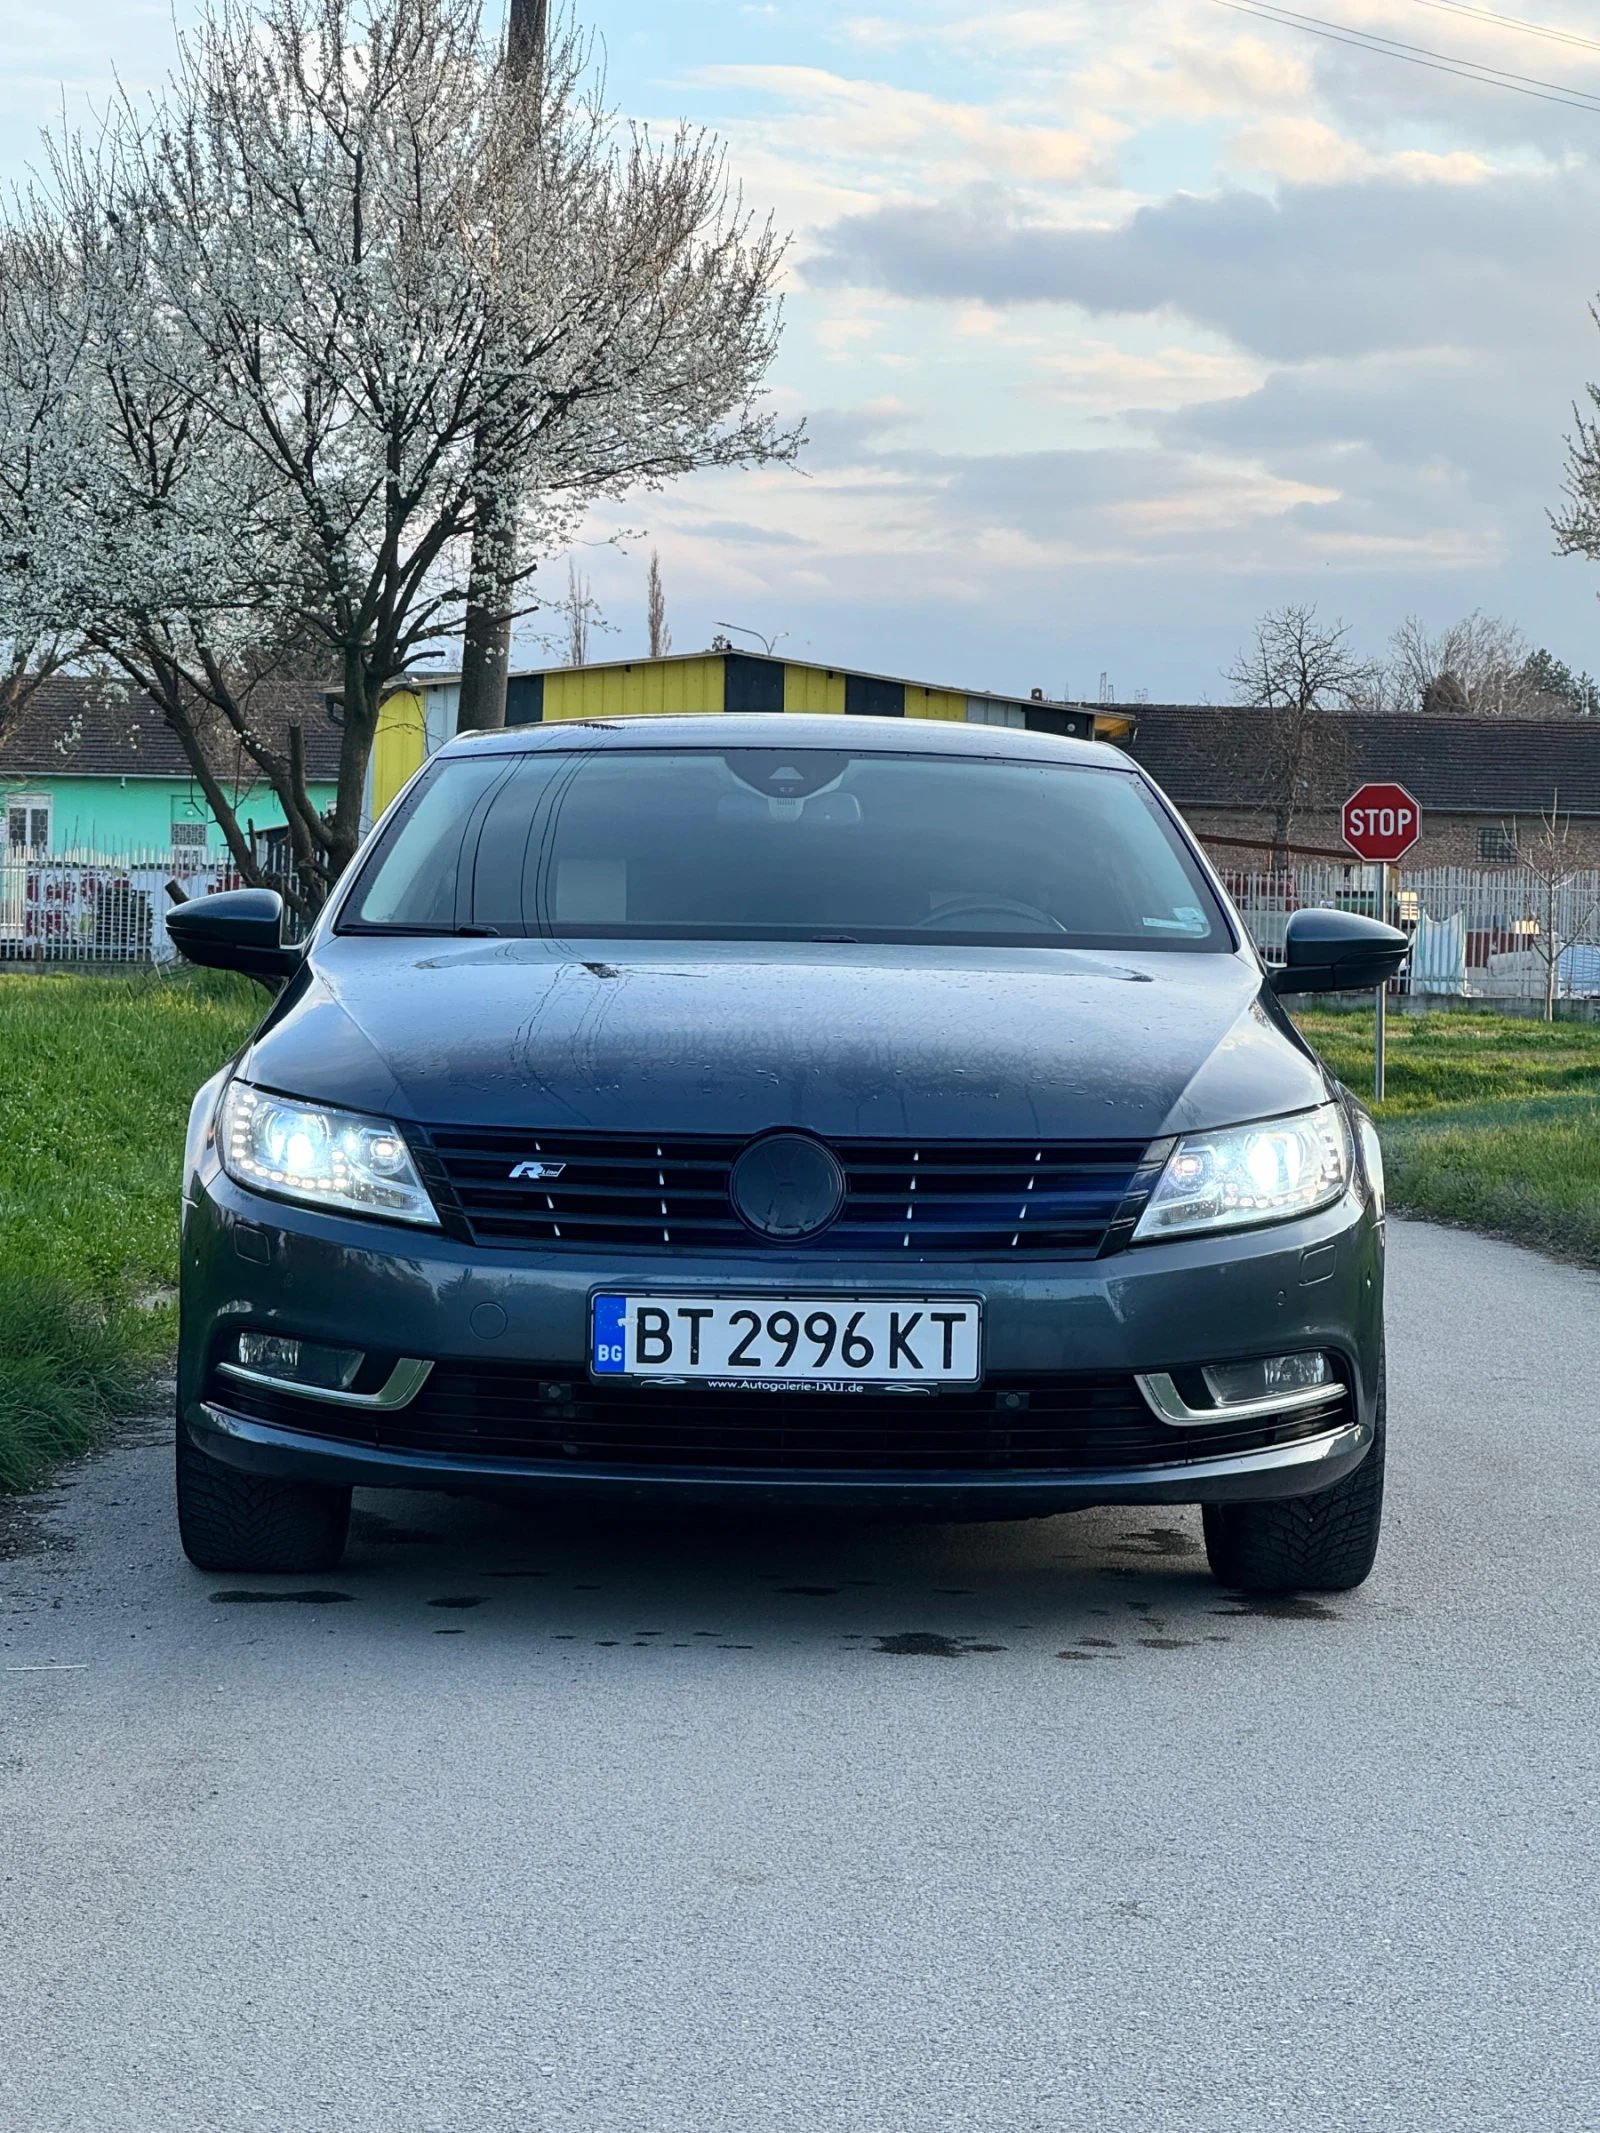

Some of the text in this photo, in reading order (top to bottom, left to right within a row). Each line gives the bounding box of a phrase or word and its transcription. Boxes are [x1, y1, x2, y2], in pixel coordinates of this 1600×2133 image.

[1349, 808, 1412, 836] STOP
[508, 1161, 544, 1179] R
[635, 1307, 967, 1370] BT 2996 KT
[598, 1344, 622, 1362] BG
[707, 1380, 864, 1393] www.Autogalerie-DALI.de
